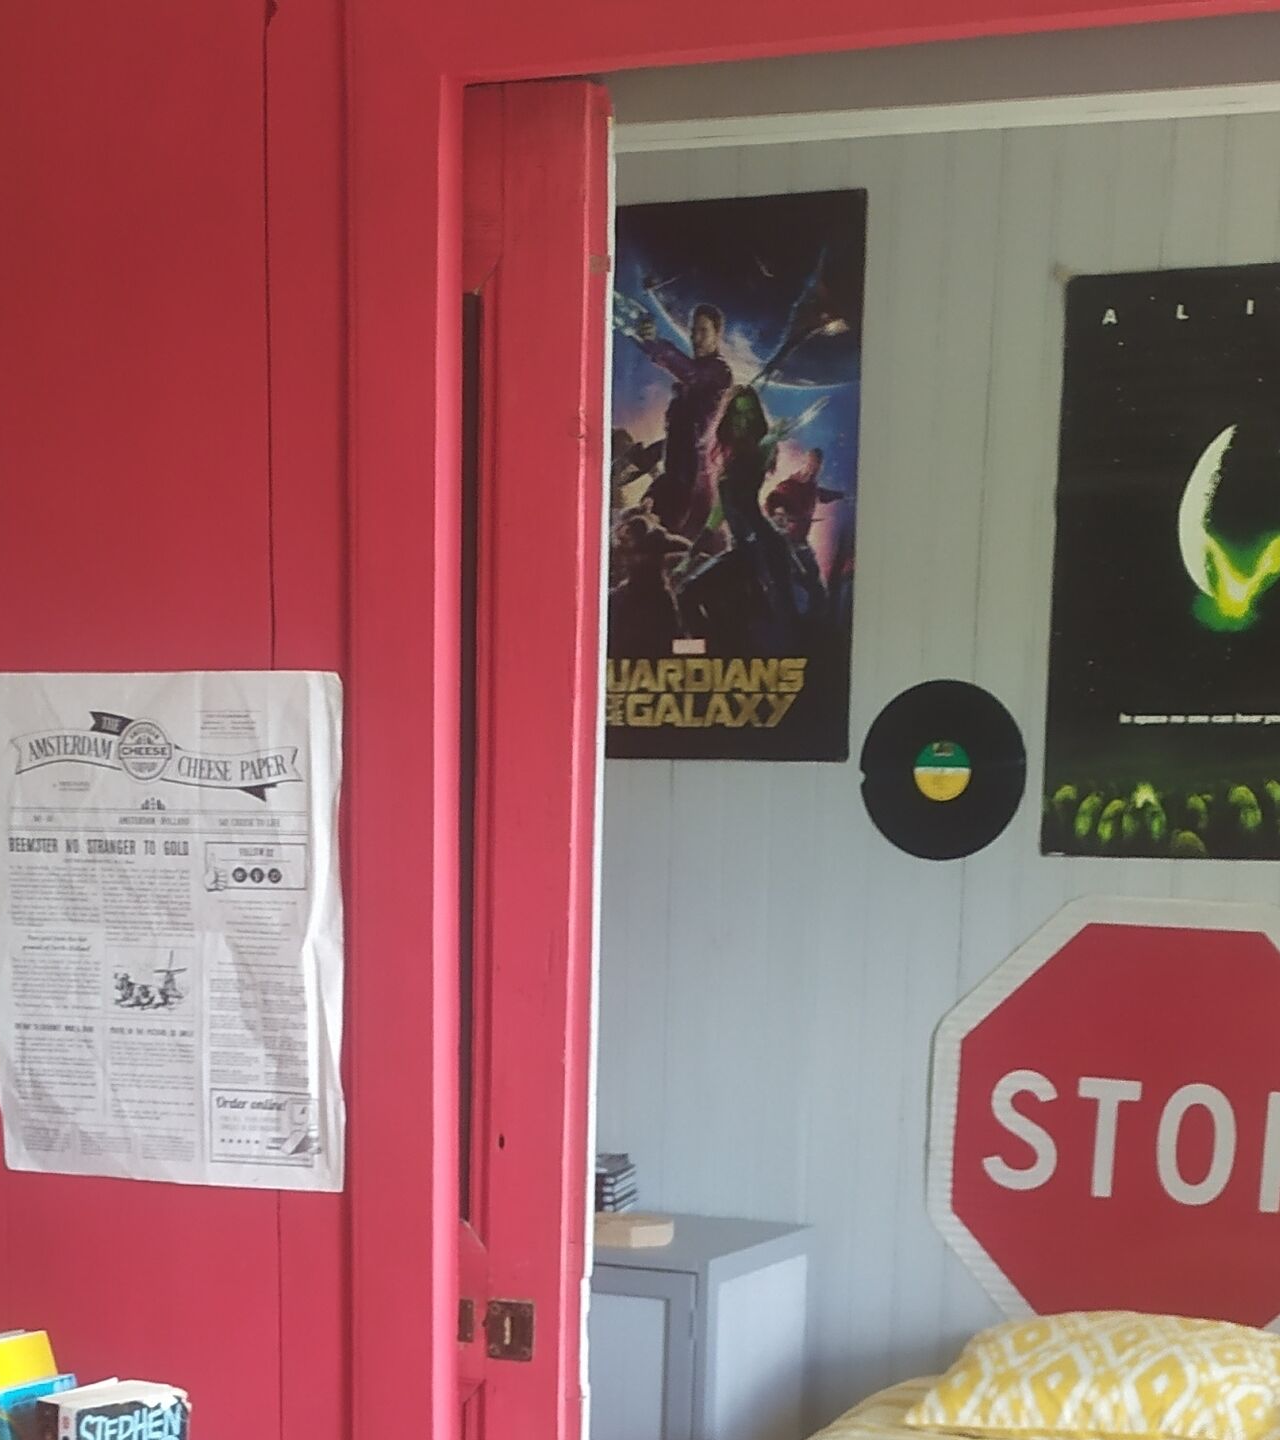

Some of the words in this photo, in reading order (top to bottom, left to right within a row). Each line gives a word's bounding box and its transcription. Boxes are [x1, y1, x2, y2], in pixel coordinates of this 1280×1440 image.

[607, 657, 808, 693] UARDIANS
[625, 693, 798, 728] GALAXY
[28, 734, 113, 762] AMSTERDAM
[177, 754, 233, 782] CHEESE
[240, 753, 288, 782] PAPER
[121, 746, 169, 757] CHEESE
[86, 838, 136, 855] STRANGER
[143, 839, 156, 856] TO
[163, 840, 190, 857] GOLD
